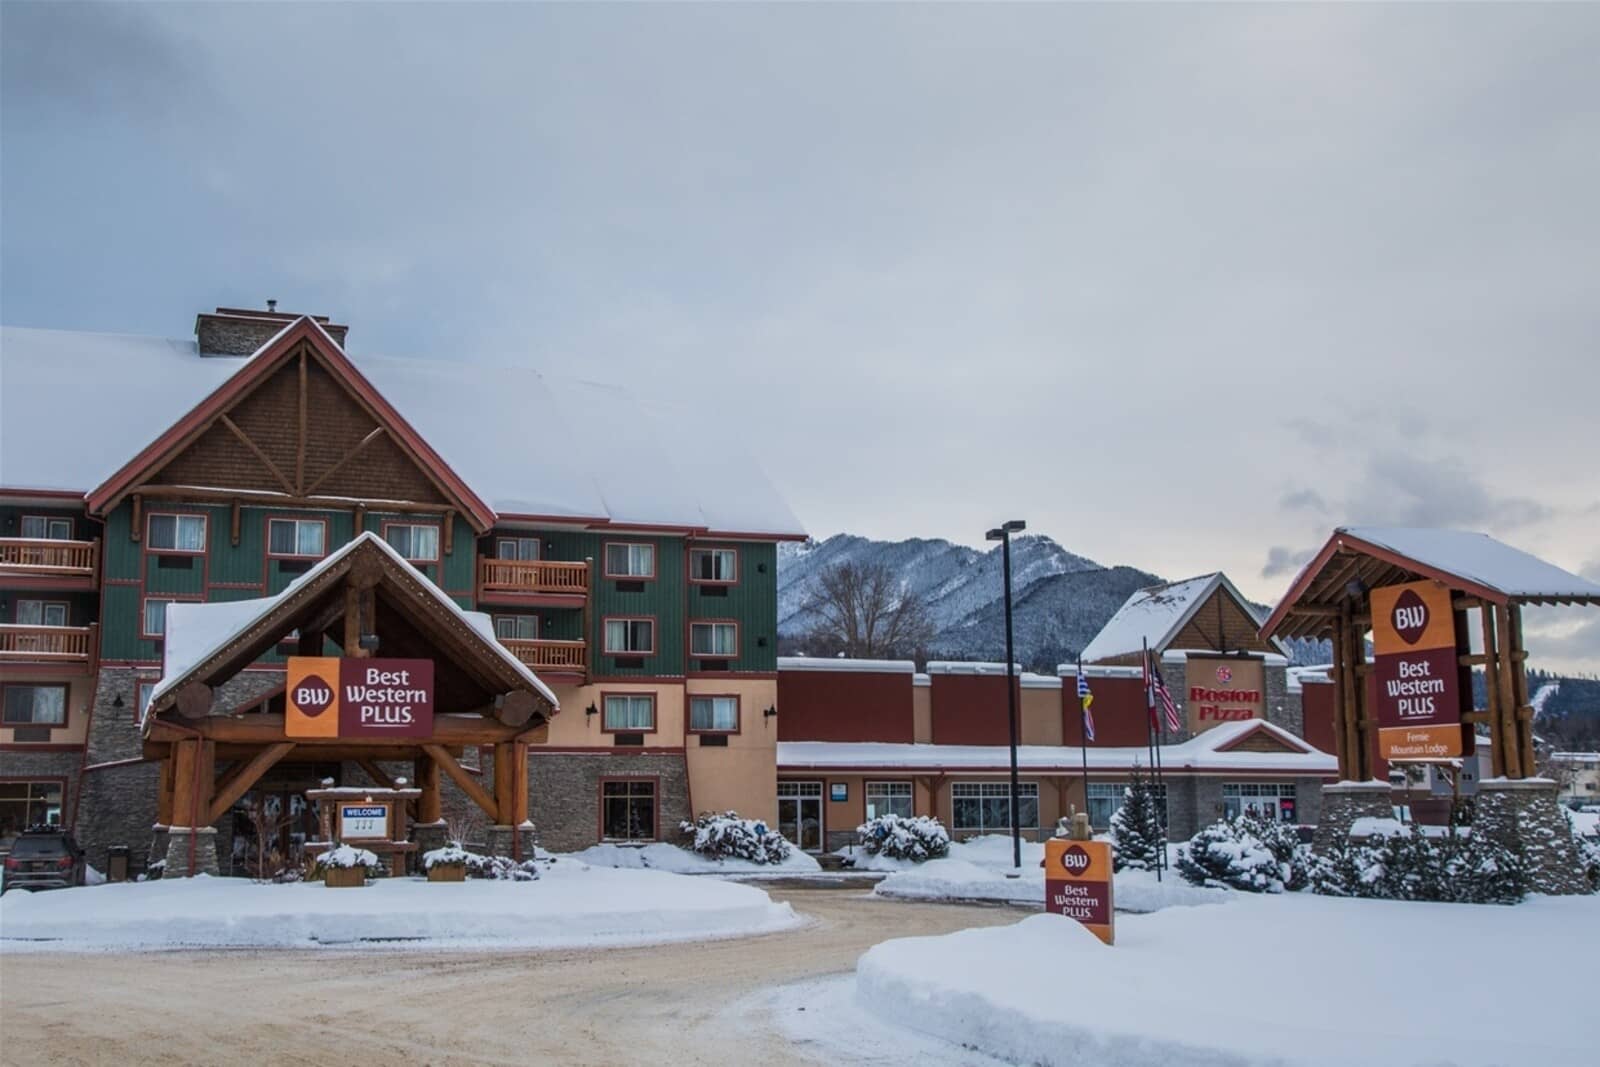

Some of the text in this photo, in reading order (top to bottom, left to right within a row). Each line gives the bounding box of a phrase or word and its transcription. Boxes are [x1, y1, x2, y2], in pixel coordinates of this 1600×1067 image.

[1395, 605, 1425, 630] BW
[366, 667, 410, 686] Best
[1399, 660, 1431, 679] Best
[297, 687, 330, 705] BW
[346, 685, 427, 703] Western
[1190, 686, 1259, 702] Boston
[1386, 679, 1445, 697] Western
[1200, 704, 1253, 720] Pizza
[1398, 696, 1436, 716] PLUS
[1390, 743, 1449, 756] Mountain Lodge
[346, 808, 383, 817] WELCOME
[1064, 854, 1088, 868] BW
[1064, 884, 1088, 896] Best
[1054, 895, 1098, 906] Western
[1062, 906, 1092, 918] PLUS
